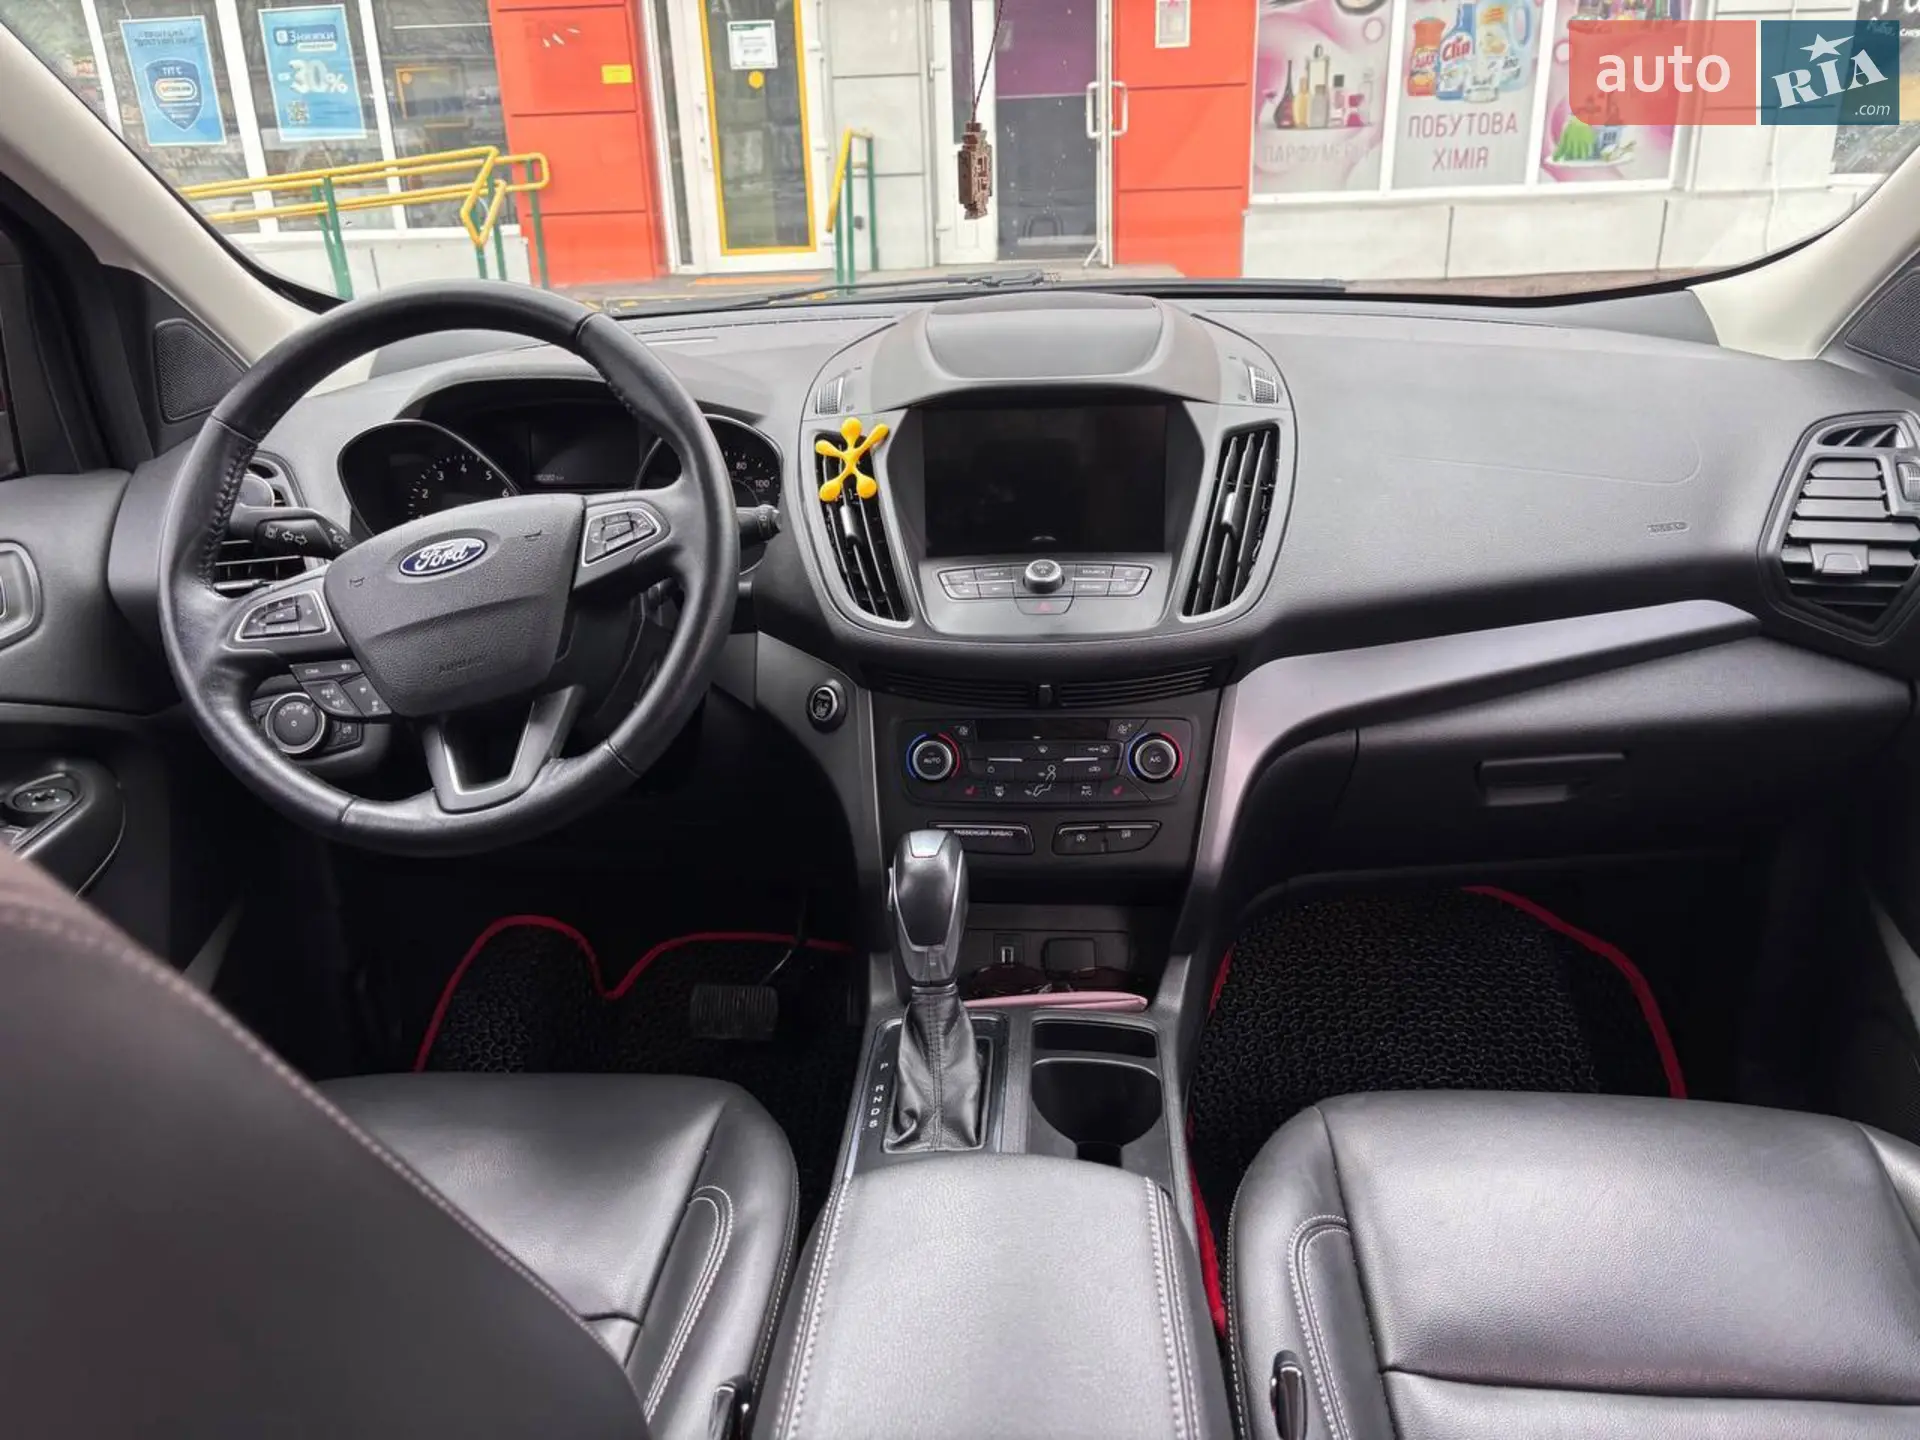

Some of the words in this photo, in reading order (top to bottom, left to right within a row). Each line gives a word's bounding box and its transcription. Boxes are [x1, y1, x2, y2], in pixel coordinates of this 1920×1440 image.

[277, 59, 348, 94] -30%
[1408, 111, 1519, 138] ПОБУТОВА
[1432, 147, 1489, 171] ХІМІЯ
[736, 461, 747, 470] 80
[422, 488, 428, 498] 2
[438, 471, 444, 480] 3
[461, 463, 467, 472] 4
[485, 470, 492, 480] 5
[502, 487, 509, 497] 6
[755, 479, 769, 487] 100
[414, 542, 469, 571] Ford
[953, 829, 989, 837] PASSENGER
